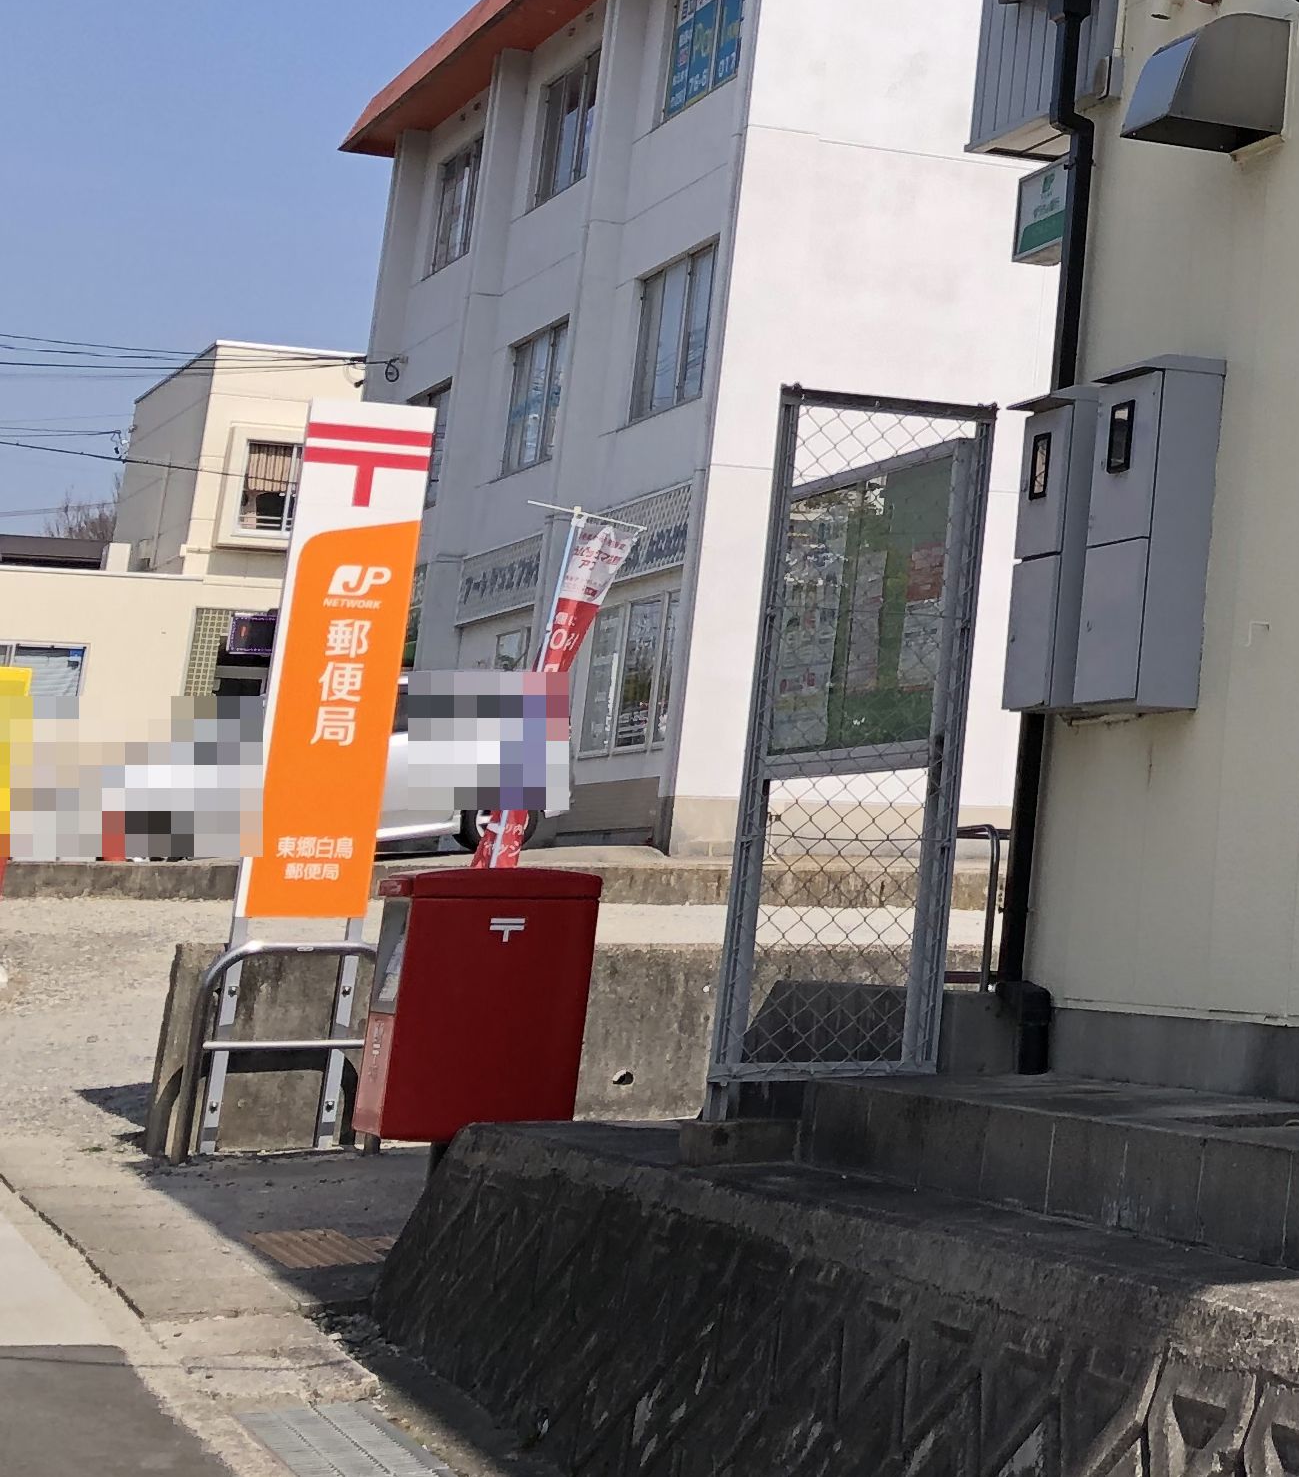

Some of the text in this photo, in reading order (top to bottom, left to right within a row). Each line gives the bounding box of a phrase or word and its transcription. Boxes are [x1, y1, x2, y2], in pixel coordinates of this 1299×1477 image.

[323, 598, 382, 610] NETWORK
[310, 618, 372, 748] 郵便局
[276, 836, 354, 860] 東郷白鳥
[283, 862, 340, 881] 郵便局
